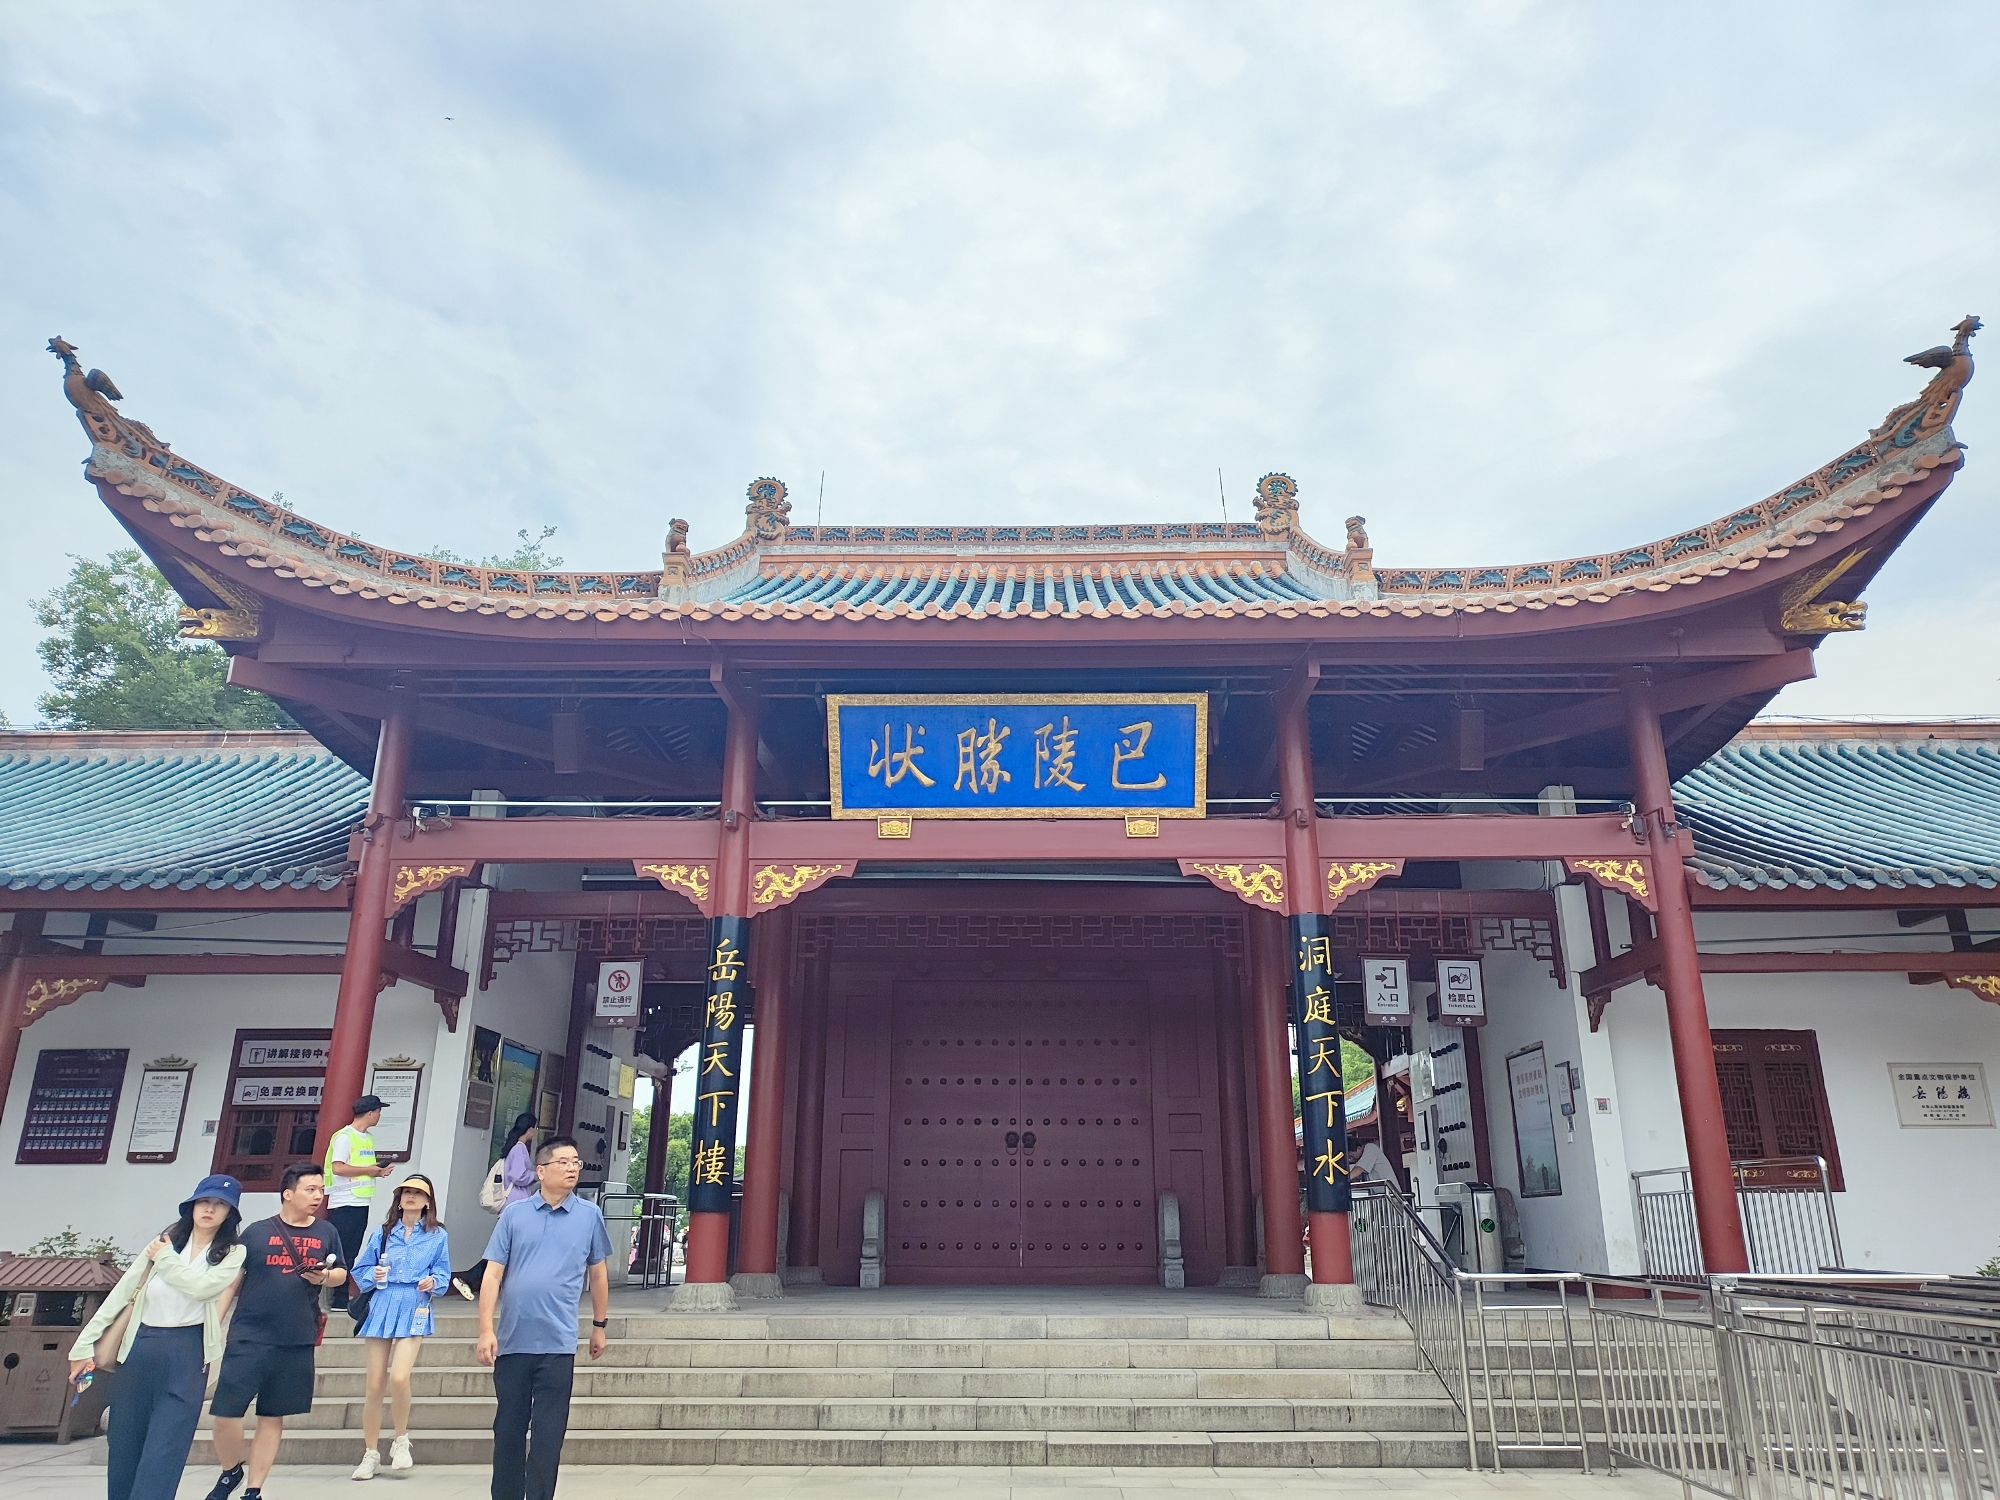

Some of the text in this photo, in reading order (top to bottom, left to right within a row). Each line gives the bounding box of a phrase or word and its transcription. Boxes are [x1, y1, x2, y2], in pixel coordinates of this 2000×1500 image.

[602, 995, 632, 1004] 禁止通行
[1377, 992, 1399, 1002] 入口
[1447, 992, 1476, 1003] 检票口
[693, 937, 745, 1187] 岳陽天下樓
[1298, 935, 1350, 1185] 洞庭天下水
[259, 1086, 324, 1097] 免票兑换窗
[302, 1237, 322, 1249] THIS
